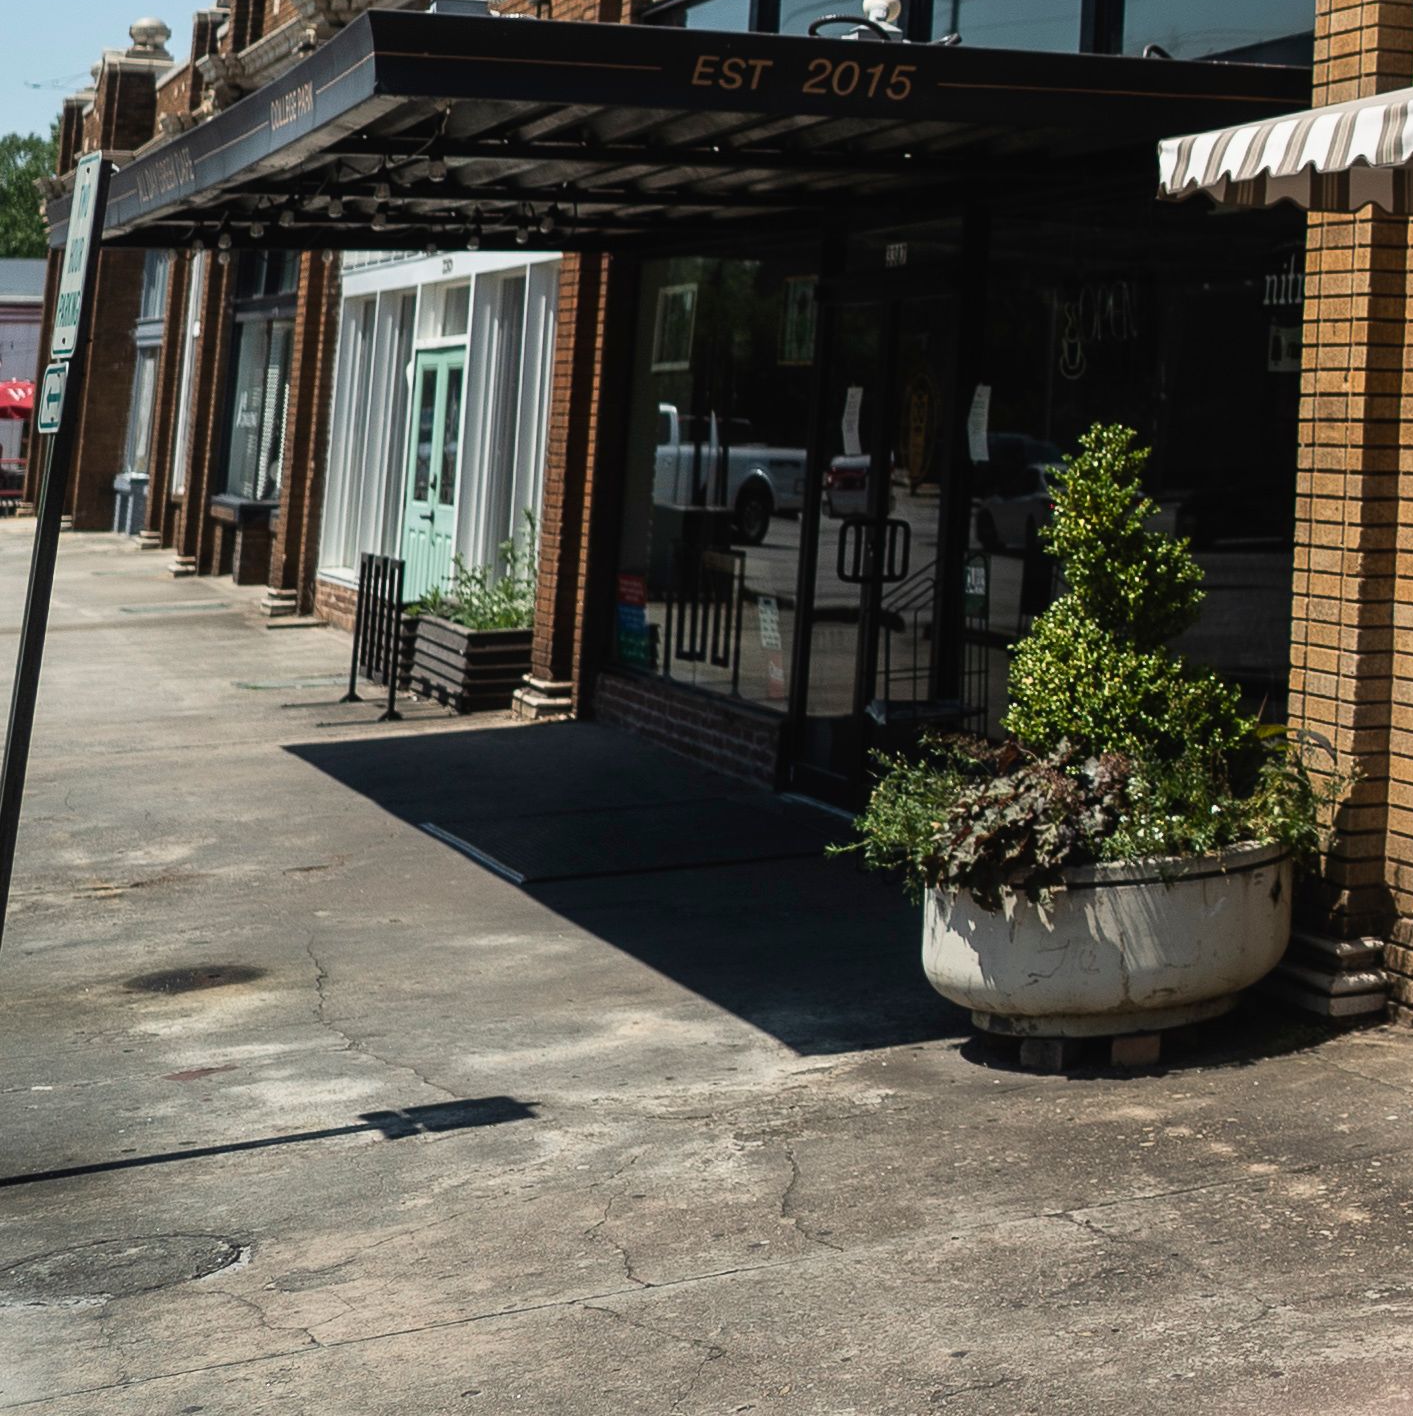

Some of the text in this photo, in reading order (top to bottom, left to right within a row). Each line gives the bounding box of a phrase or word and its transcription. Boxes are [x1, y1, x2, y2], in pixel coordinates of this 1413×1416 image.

[691, 54, 918, 101] EST 2015
[271, 80, 314, 132] COLLEGE PARK
[55, 290, 81, 328] PARKING
